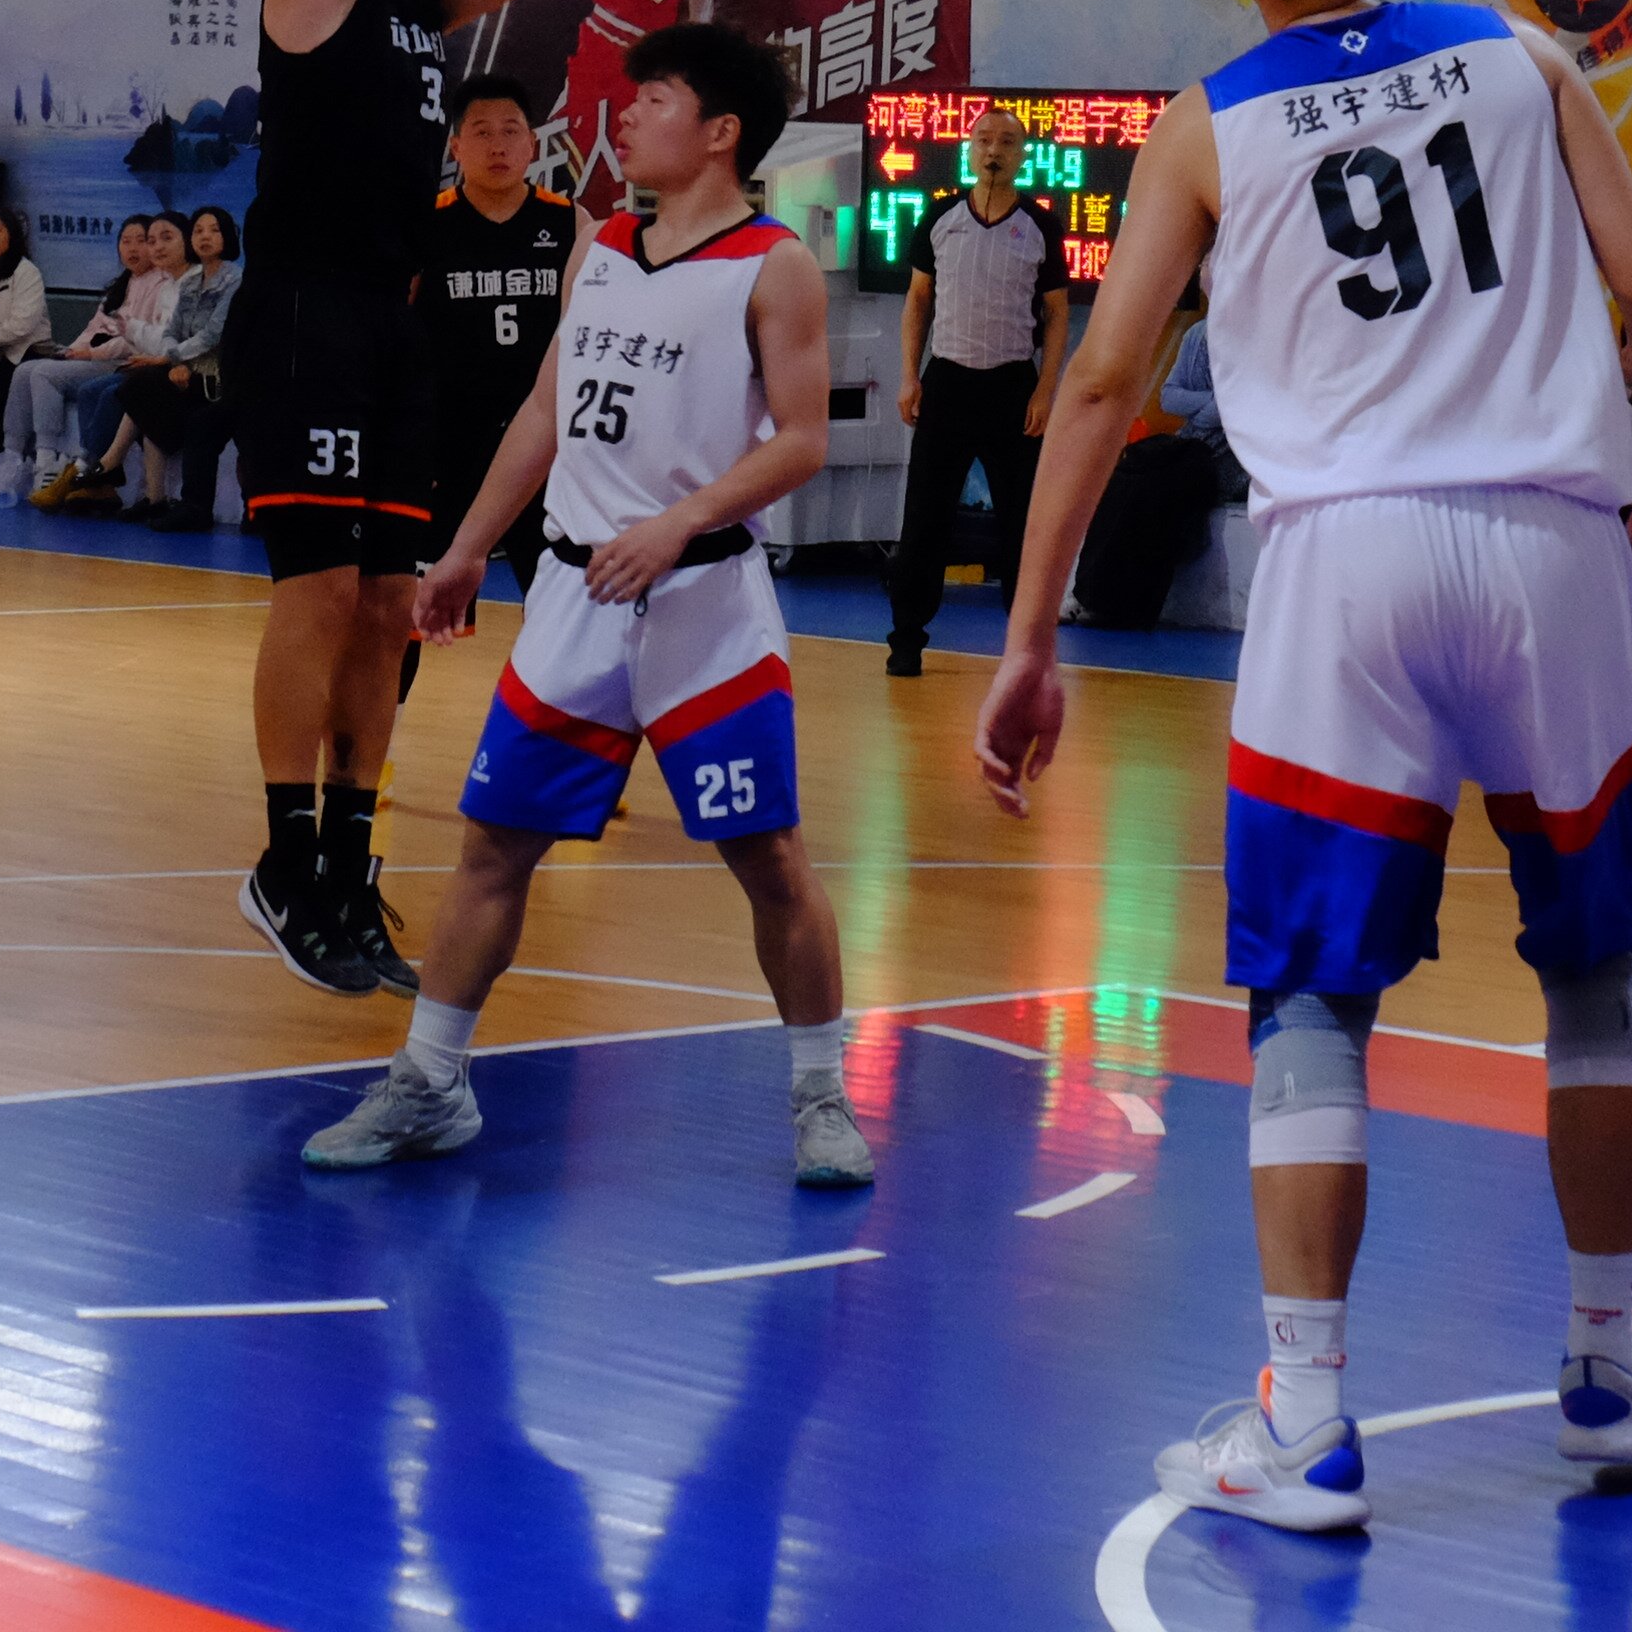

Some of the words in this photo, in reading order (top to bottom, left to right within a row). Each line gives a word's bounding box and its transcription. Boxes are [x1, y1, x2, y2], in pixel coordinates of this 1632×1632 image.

[868, 92, 989, 140] 河湾社区
[1282, 56, 1471, 139] 强宇建材
[869, 190, 924, 262] 47
[1311, 120, 1504, 322] 91
[446, 267, 559, 302] 谦城金鸿
[493, 304, 519, 346] 6
[568, 378, 635, 445] 25
[307, 426, 361, 479] 33
[694, 757, 757, 820] 25
